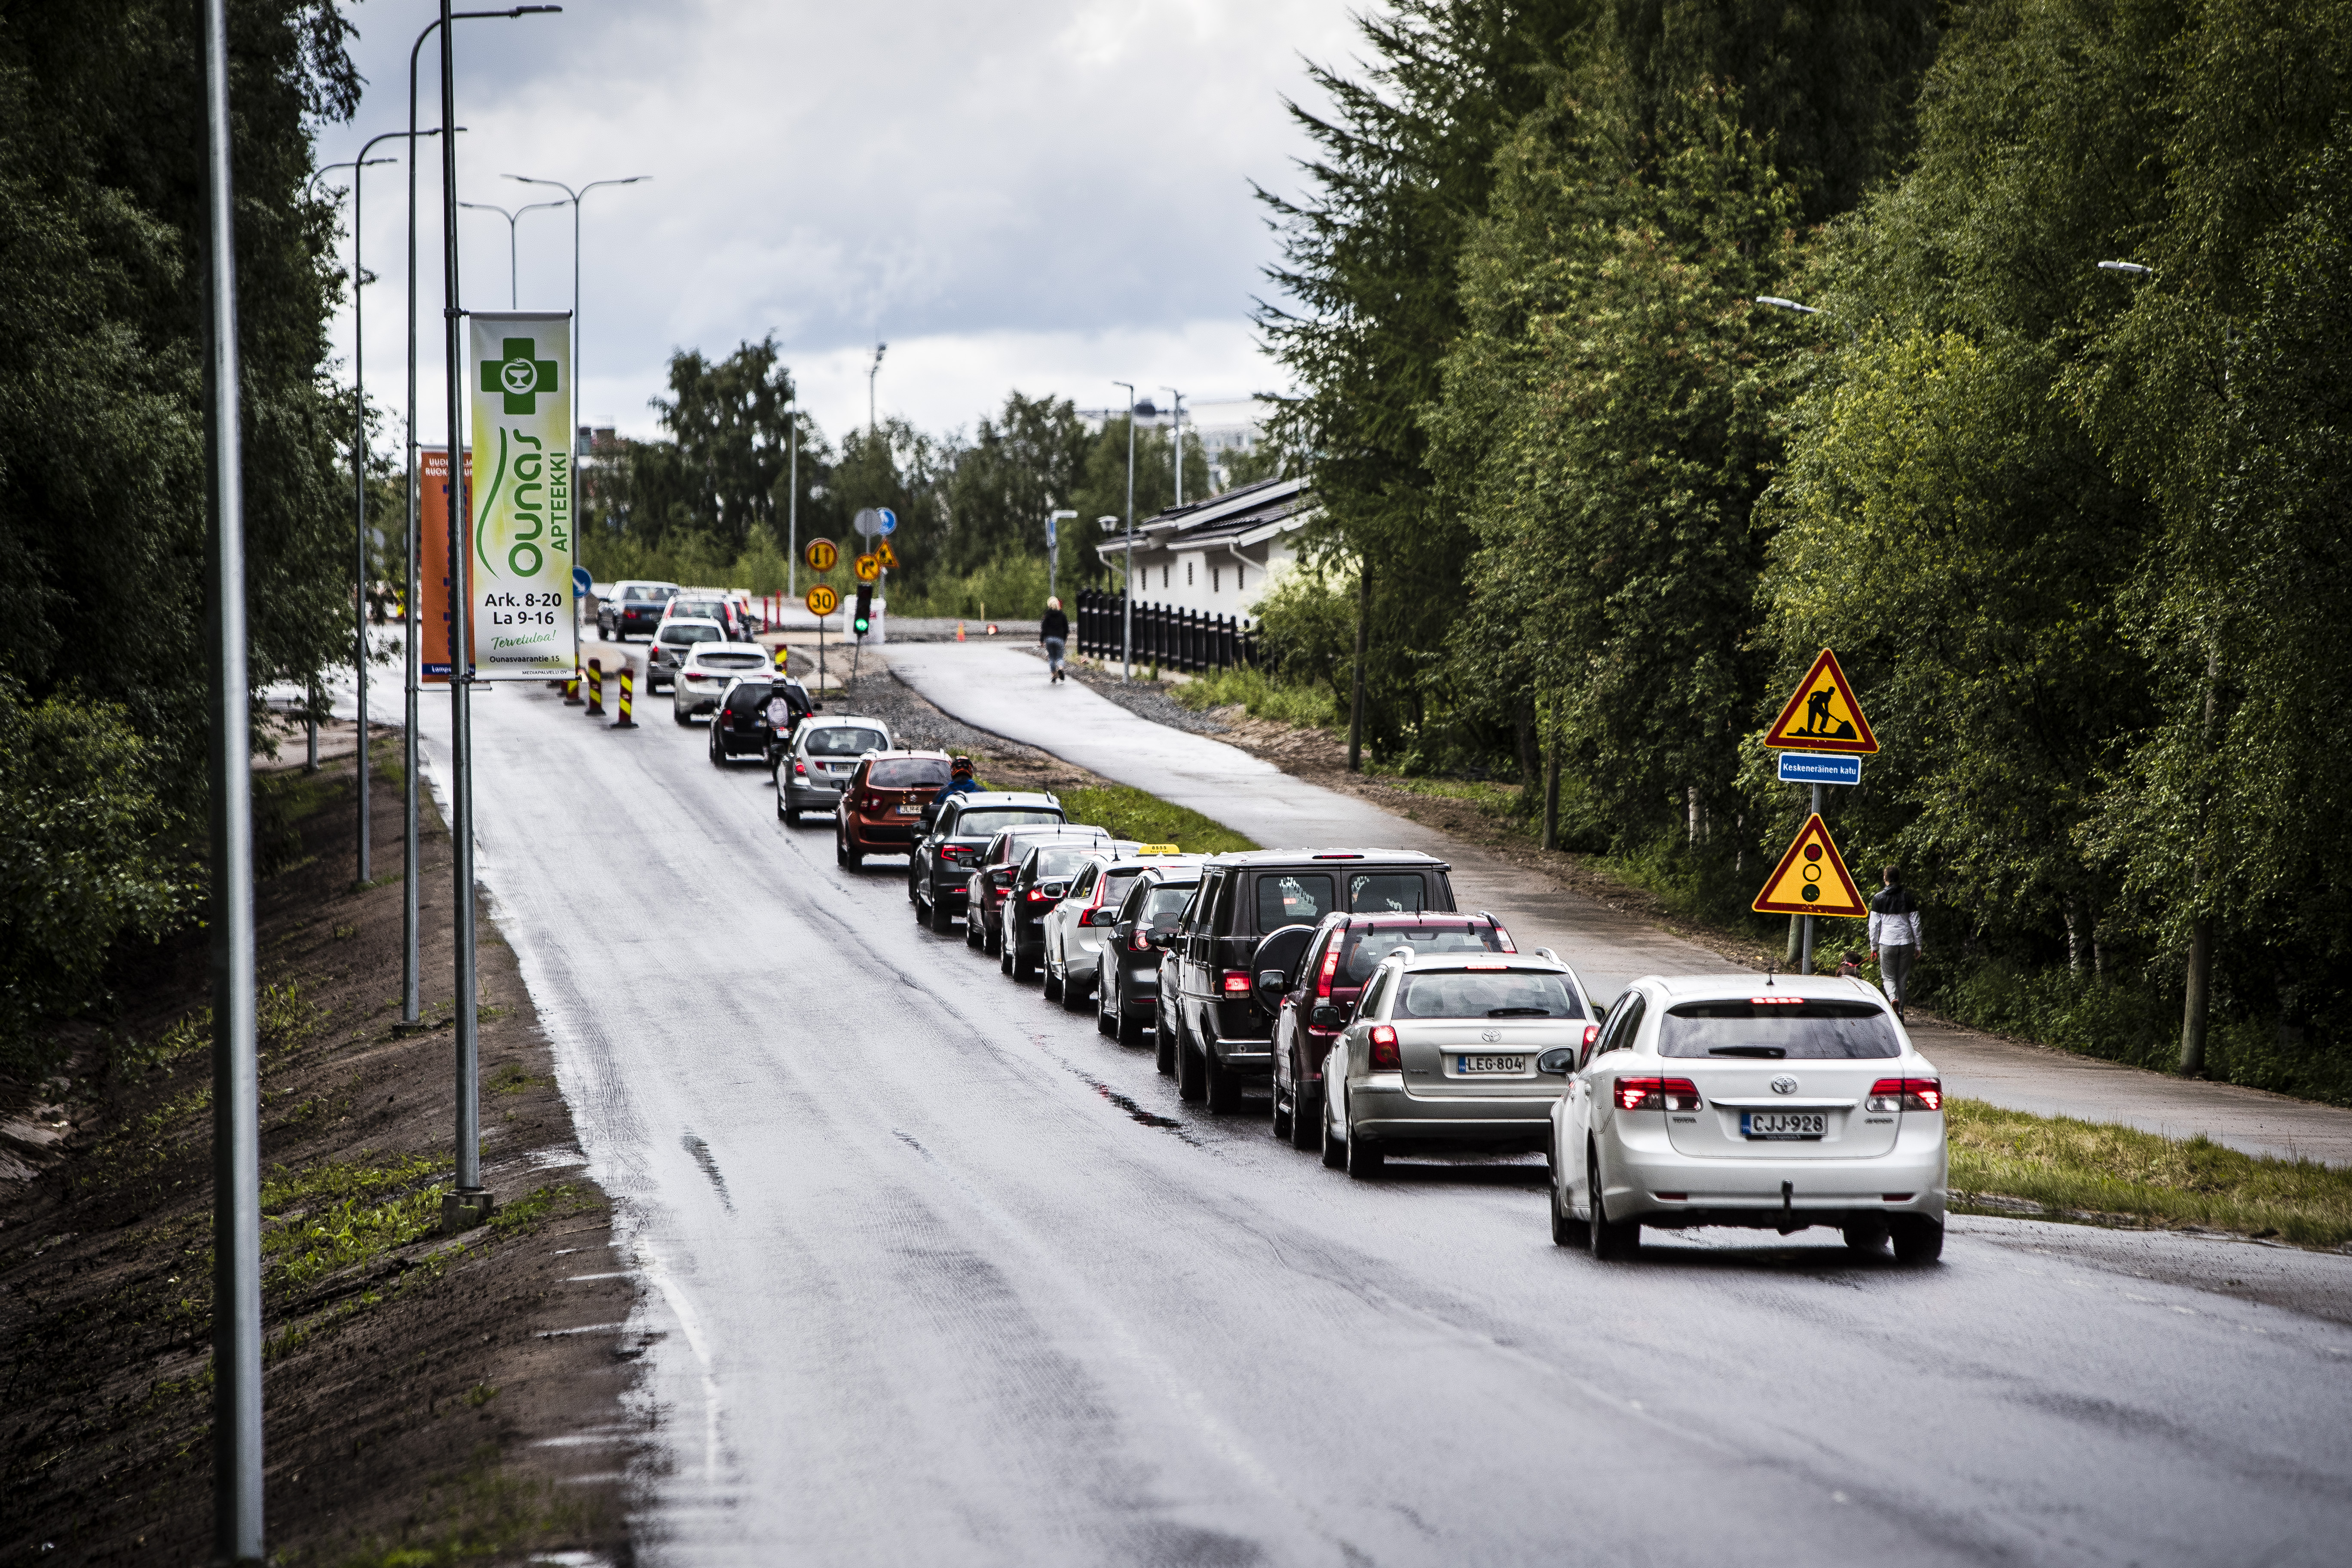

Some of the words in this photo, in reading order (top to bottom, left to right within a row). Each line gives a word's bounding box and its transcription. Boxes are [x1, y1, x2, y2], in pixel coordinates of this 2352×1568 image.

[550, 452, 567, 552] APTEEKKI
[484, 592, 520, 607] Ark.
[525, 593, 562, 607] 8-20
[812, 593, 832, 609] 30
[493, 612, 513, 624] La
[518, 611, 554, 625] 9-16
[491, 630, 556, 650] Tervetuloa!
[1783, 763, 1838, 774] Keskeneräinen
[1840, 766, 1856, 775] katu
[1467, 1057, 1523, 1071] LEG-804
[1753, 1115, 1824, 1132] CJJ-928
